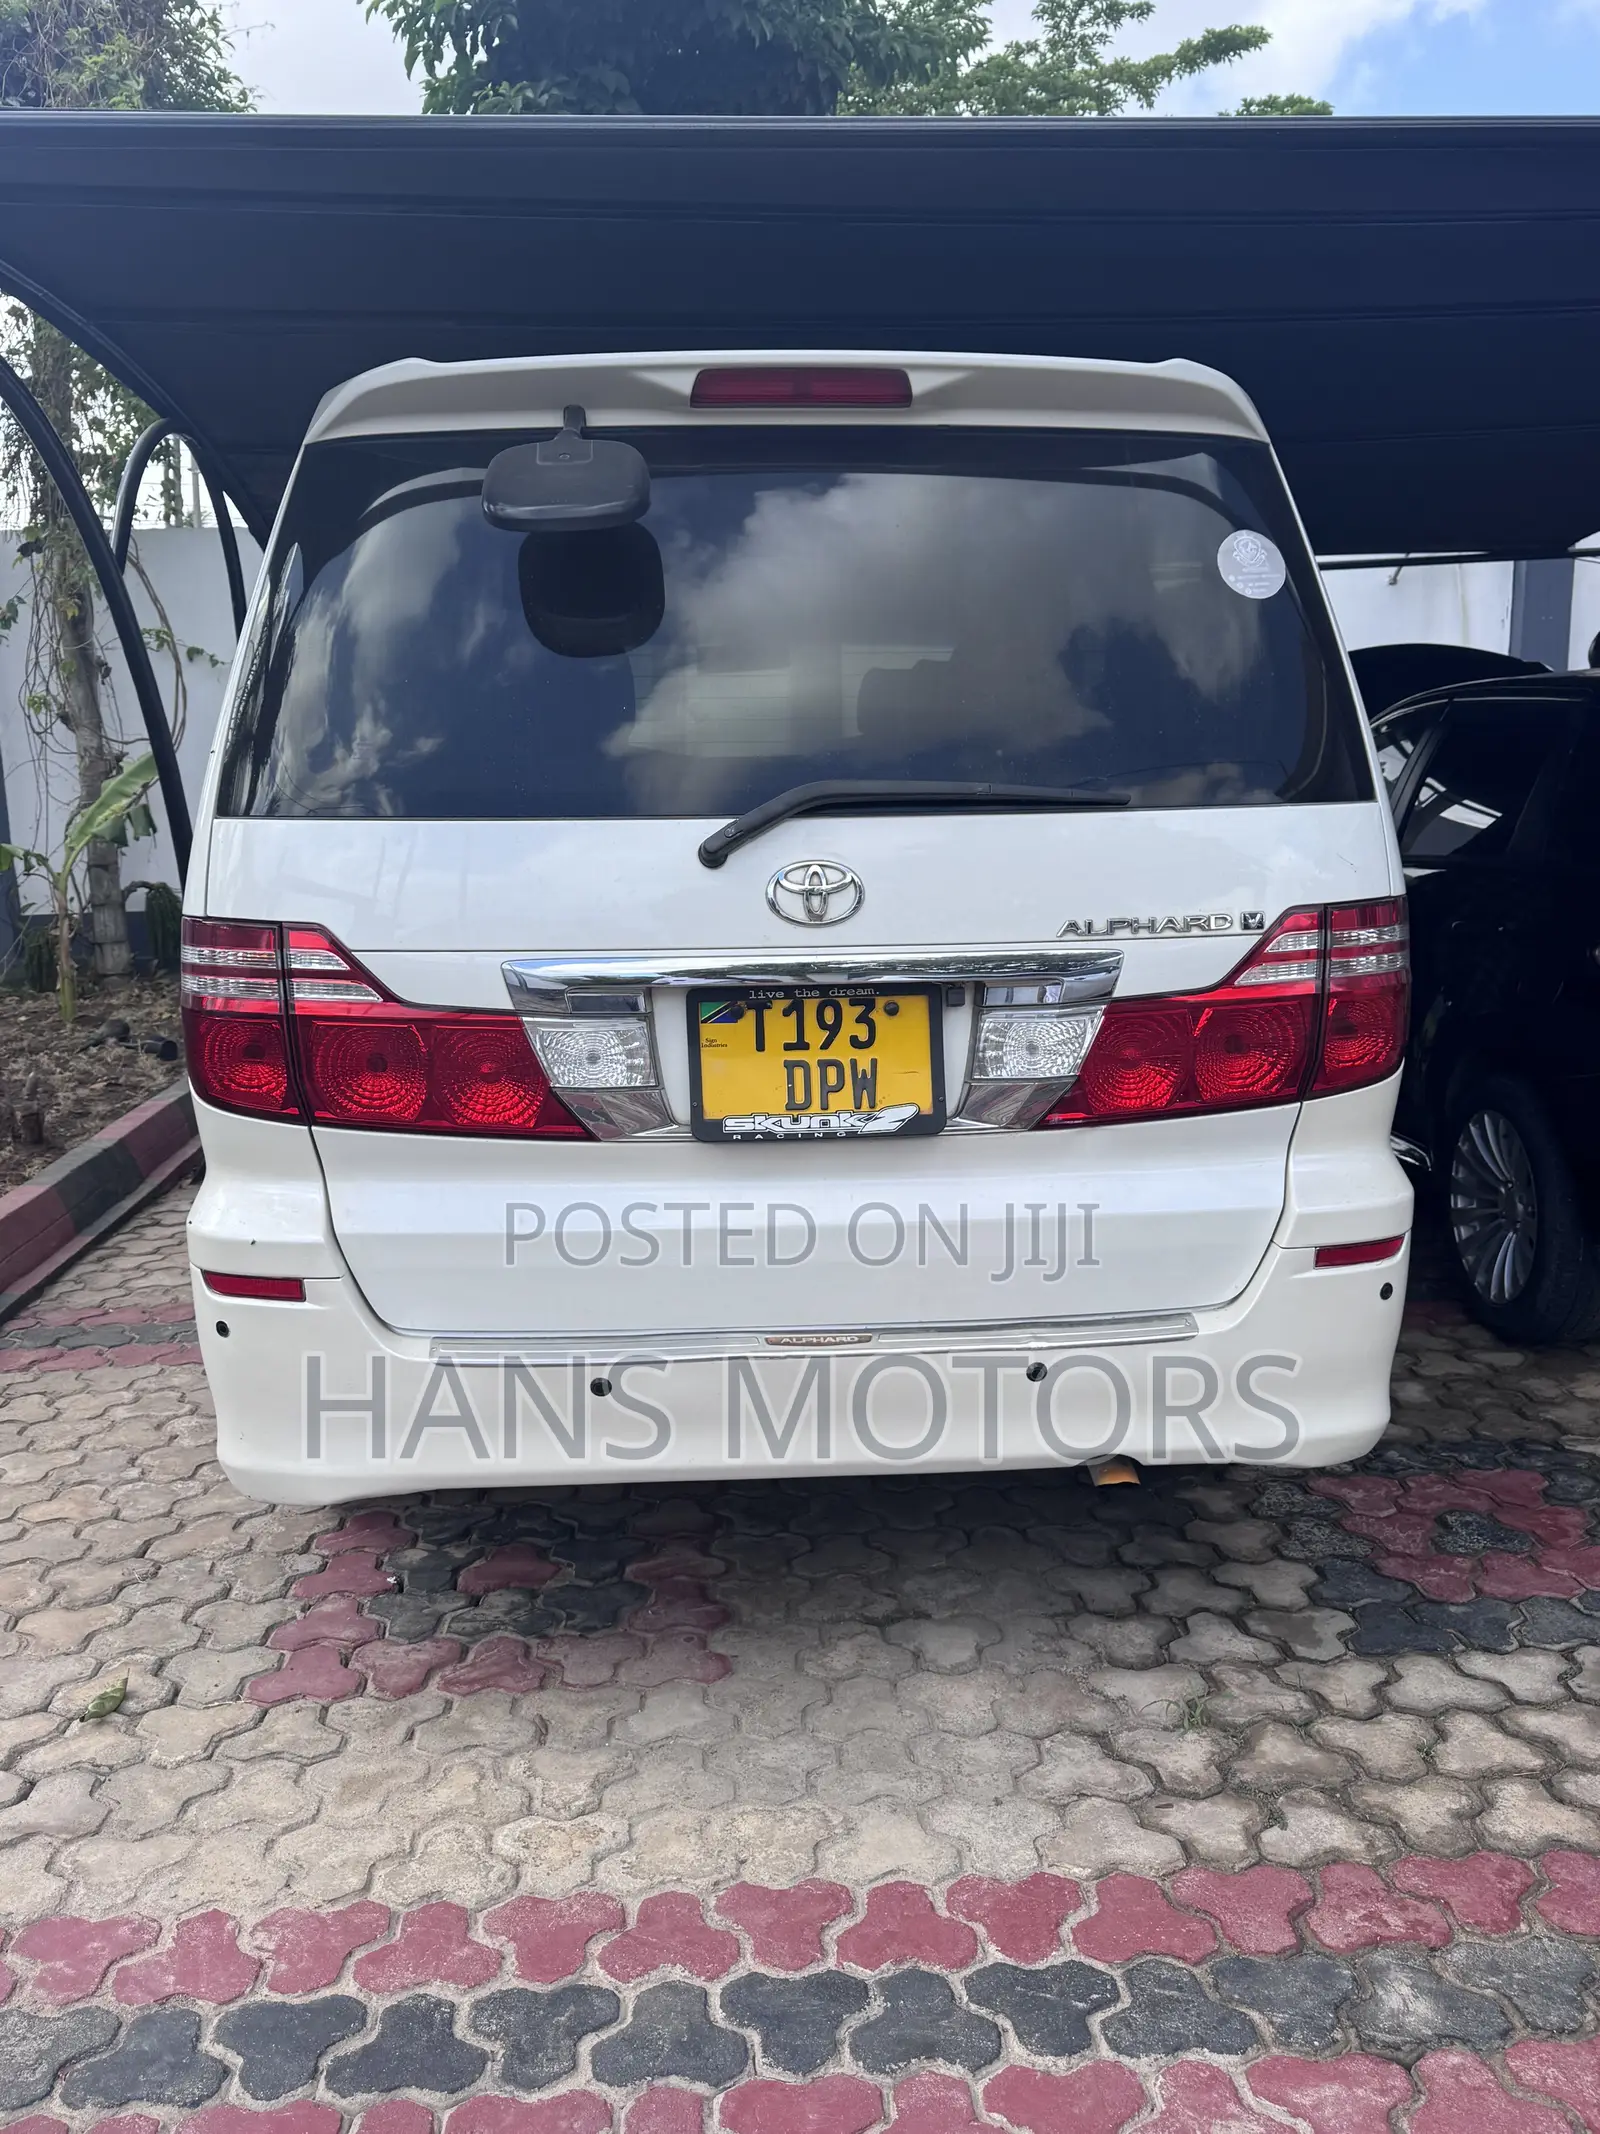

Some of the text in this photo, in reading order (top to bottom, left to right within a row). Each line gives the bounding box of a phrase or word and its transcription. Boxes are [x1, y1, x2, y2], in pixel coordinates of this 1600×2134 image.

[1056, 913, 1233, 938] ALPHARD
[749, 986, 880, 1000] live the dream.
[783, 1057, 878, 1110] DPW
[780, 1336, 859, 1344] ALPHARD
